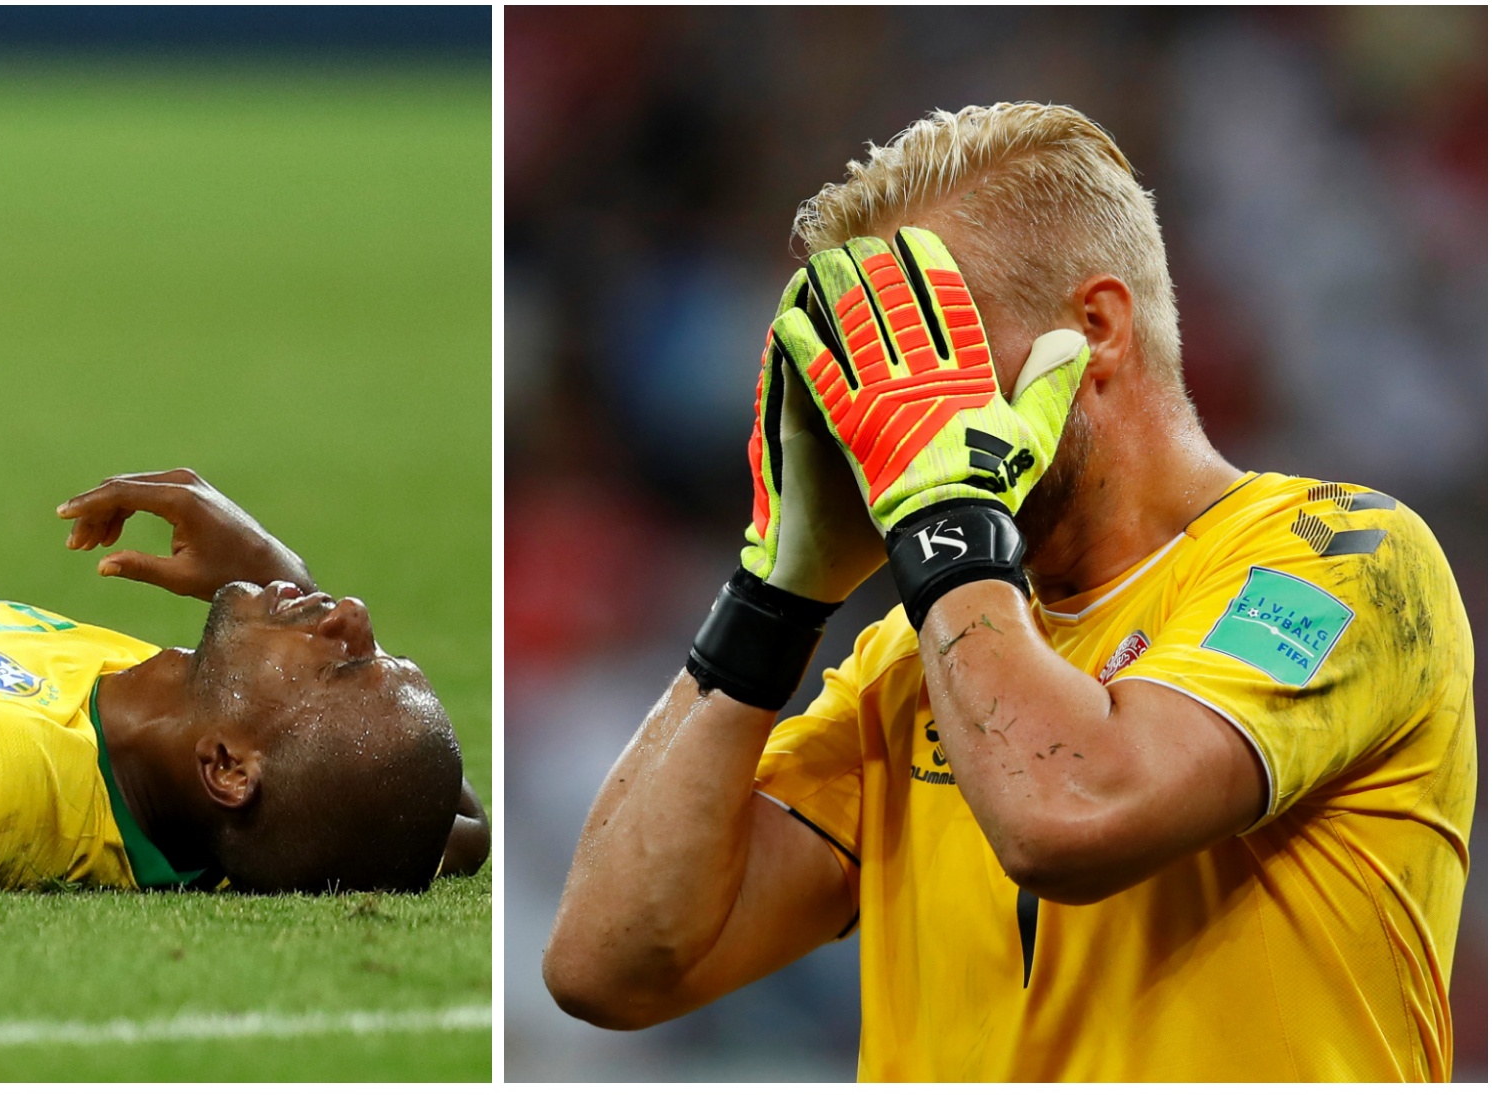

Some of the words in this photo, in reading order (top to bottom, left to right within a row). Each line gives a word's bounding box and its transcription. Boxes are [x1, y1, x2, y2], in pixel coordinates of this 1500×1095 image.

[912, 518, 968, 564] KS
[1243, 596, 1328, 641] LIVING
[1277, 642, 1310, 670] FIFA
[911, 765, 956, 785] umme
